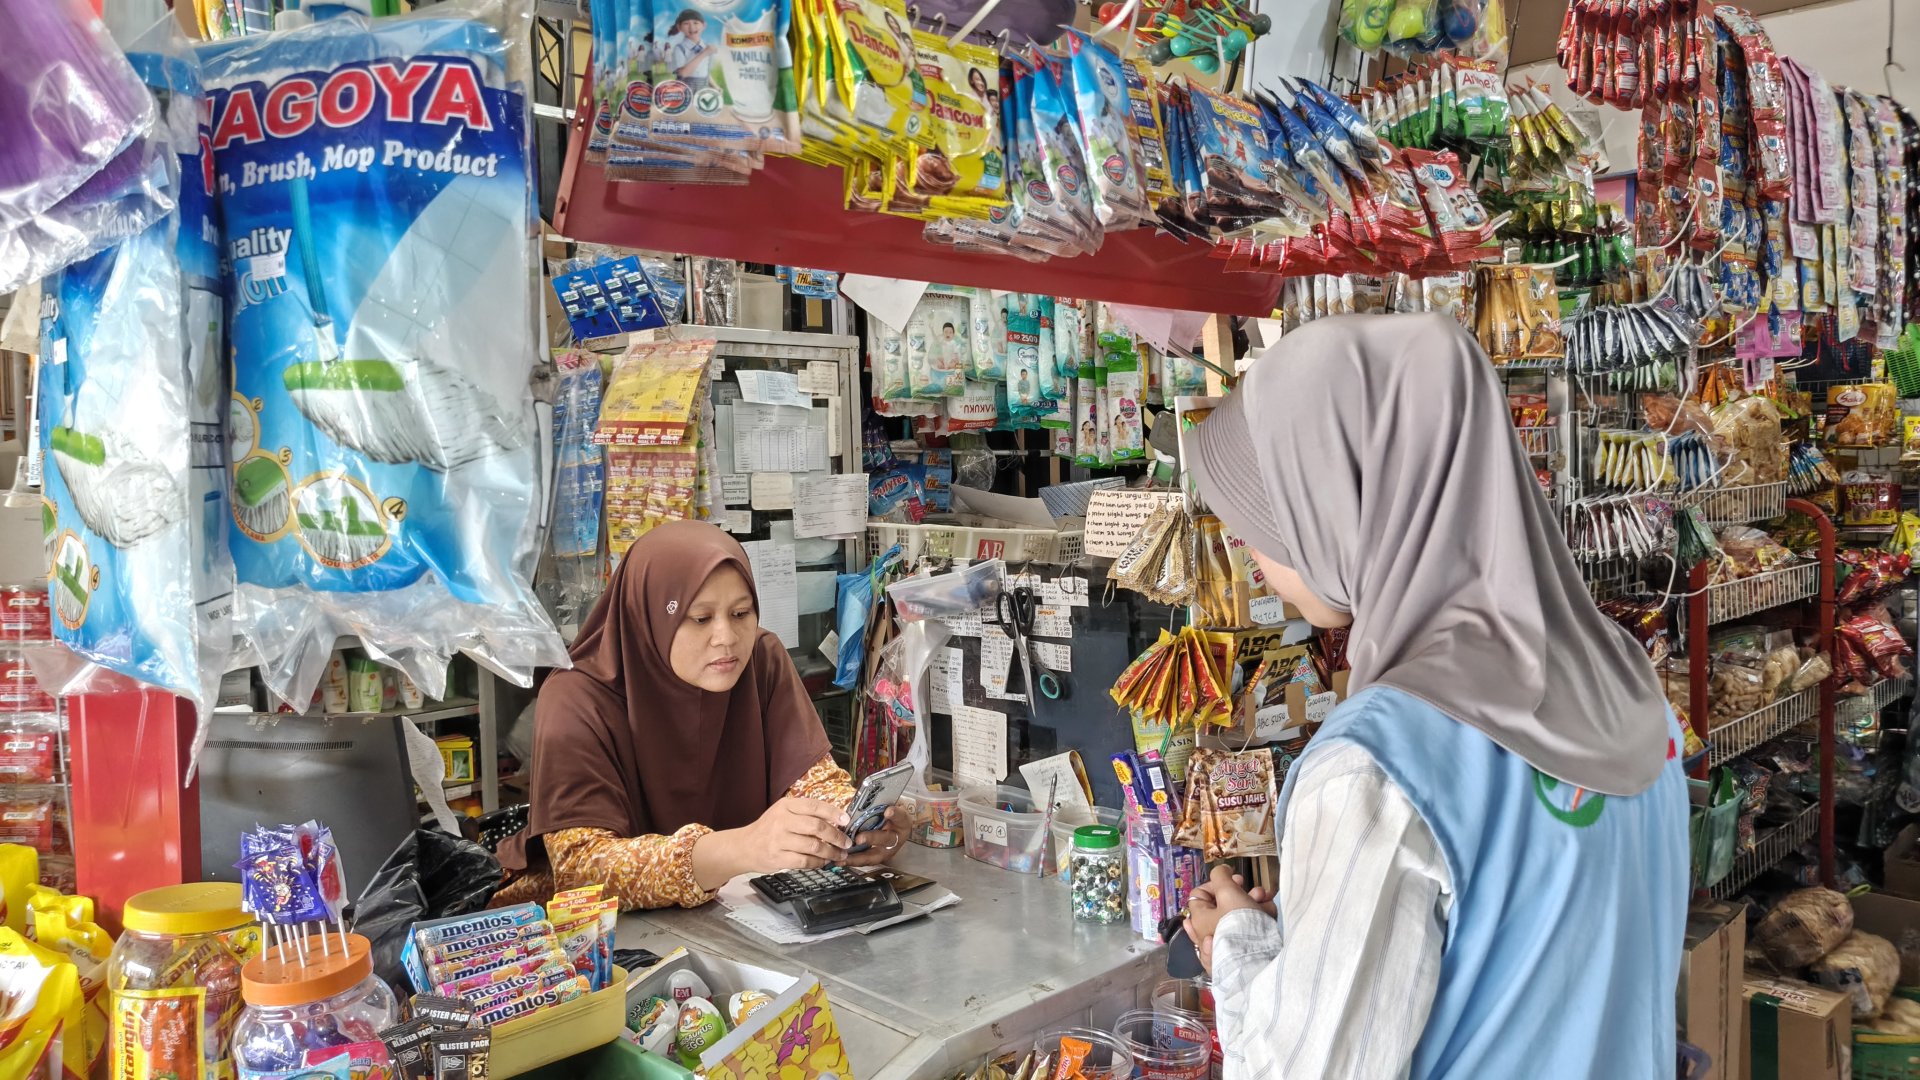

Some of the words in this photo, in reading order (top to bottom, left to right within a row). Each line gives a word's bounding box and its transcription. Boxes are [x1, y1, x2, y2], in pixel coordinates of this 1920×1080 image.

[848, 20, 901, 62] Dancow
[730, 50, 772, 65] VANILLA
[207, 61, 495, 150] AGOYA
[241, 152, 317, 189] Brush,
[321, 144, 376, 173] Mop
[382, 139, 498, 178] Product
[230, 227, 293, 259] ality
[281, 448, 291, 464] 3
[387, 500, 405, 519] 4
[1235, 633, 1281, 660] ABC
[1261, 654, 1304, 681] ABC
[1210, 758, 1261, 781] Anget
[1225, 777, 1258, 792] Sari
[1218, 795, 1244, 809] SUSU
[1243, 792, 1267, 806] JAHE
[569, 897, 588, 906] 1.000
[441, 914, 514, 939] mentos
[445, 928, 519, 954] mentos
[461, 972, 540, 1001] mentos
[450, 1012, 471, 1022] PACK
[480, 989, 558, 1026] mentos
[391, 1034, 418, 1048] BLISTER
[417, 1025, 435, 1040] PACK
[439, 1040, 470, 1051] BLISTER
[469, 1038, 490, 1050] PACK
[1177, 1031, 1194, 1041] EXTRA
[350, 1057, 372, 1067] elaxa
